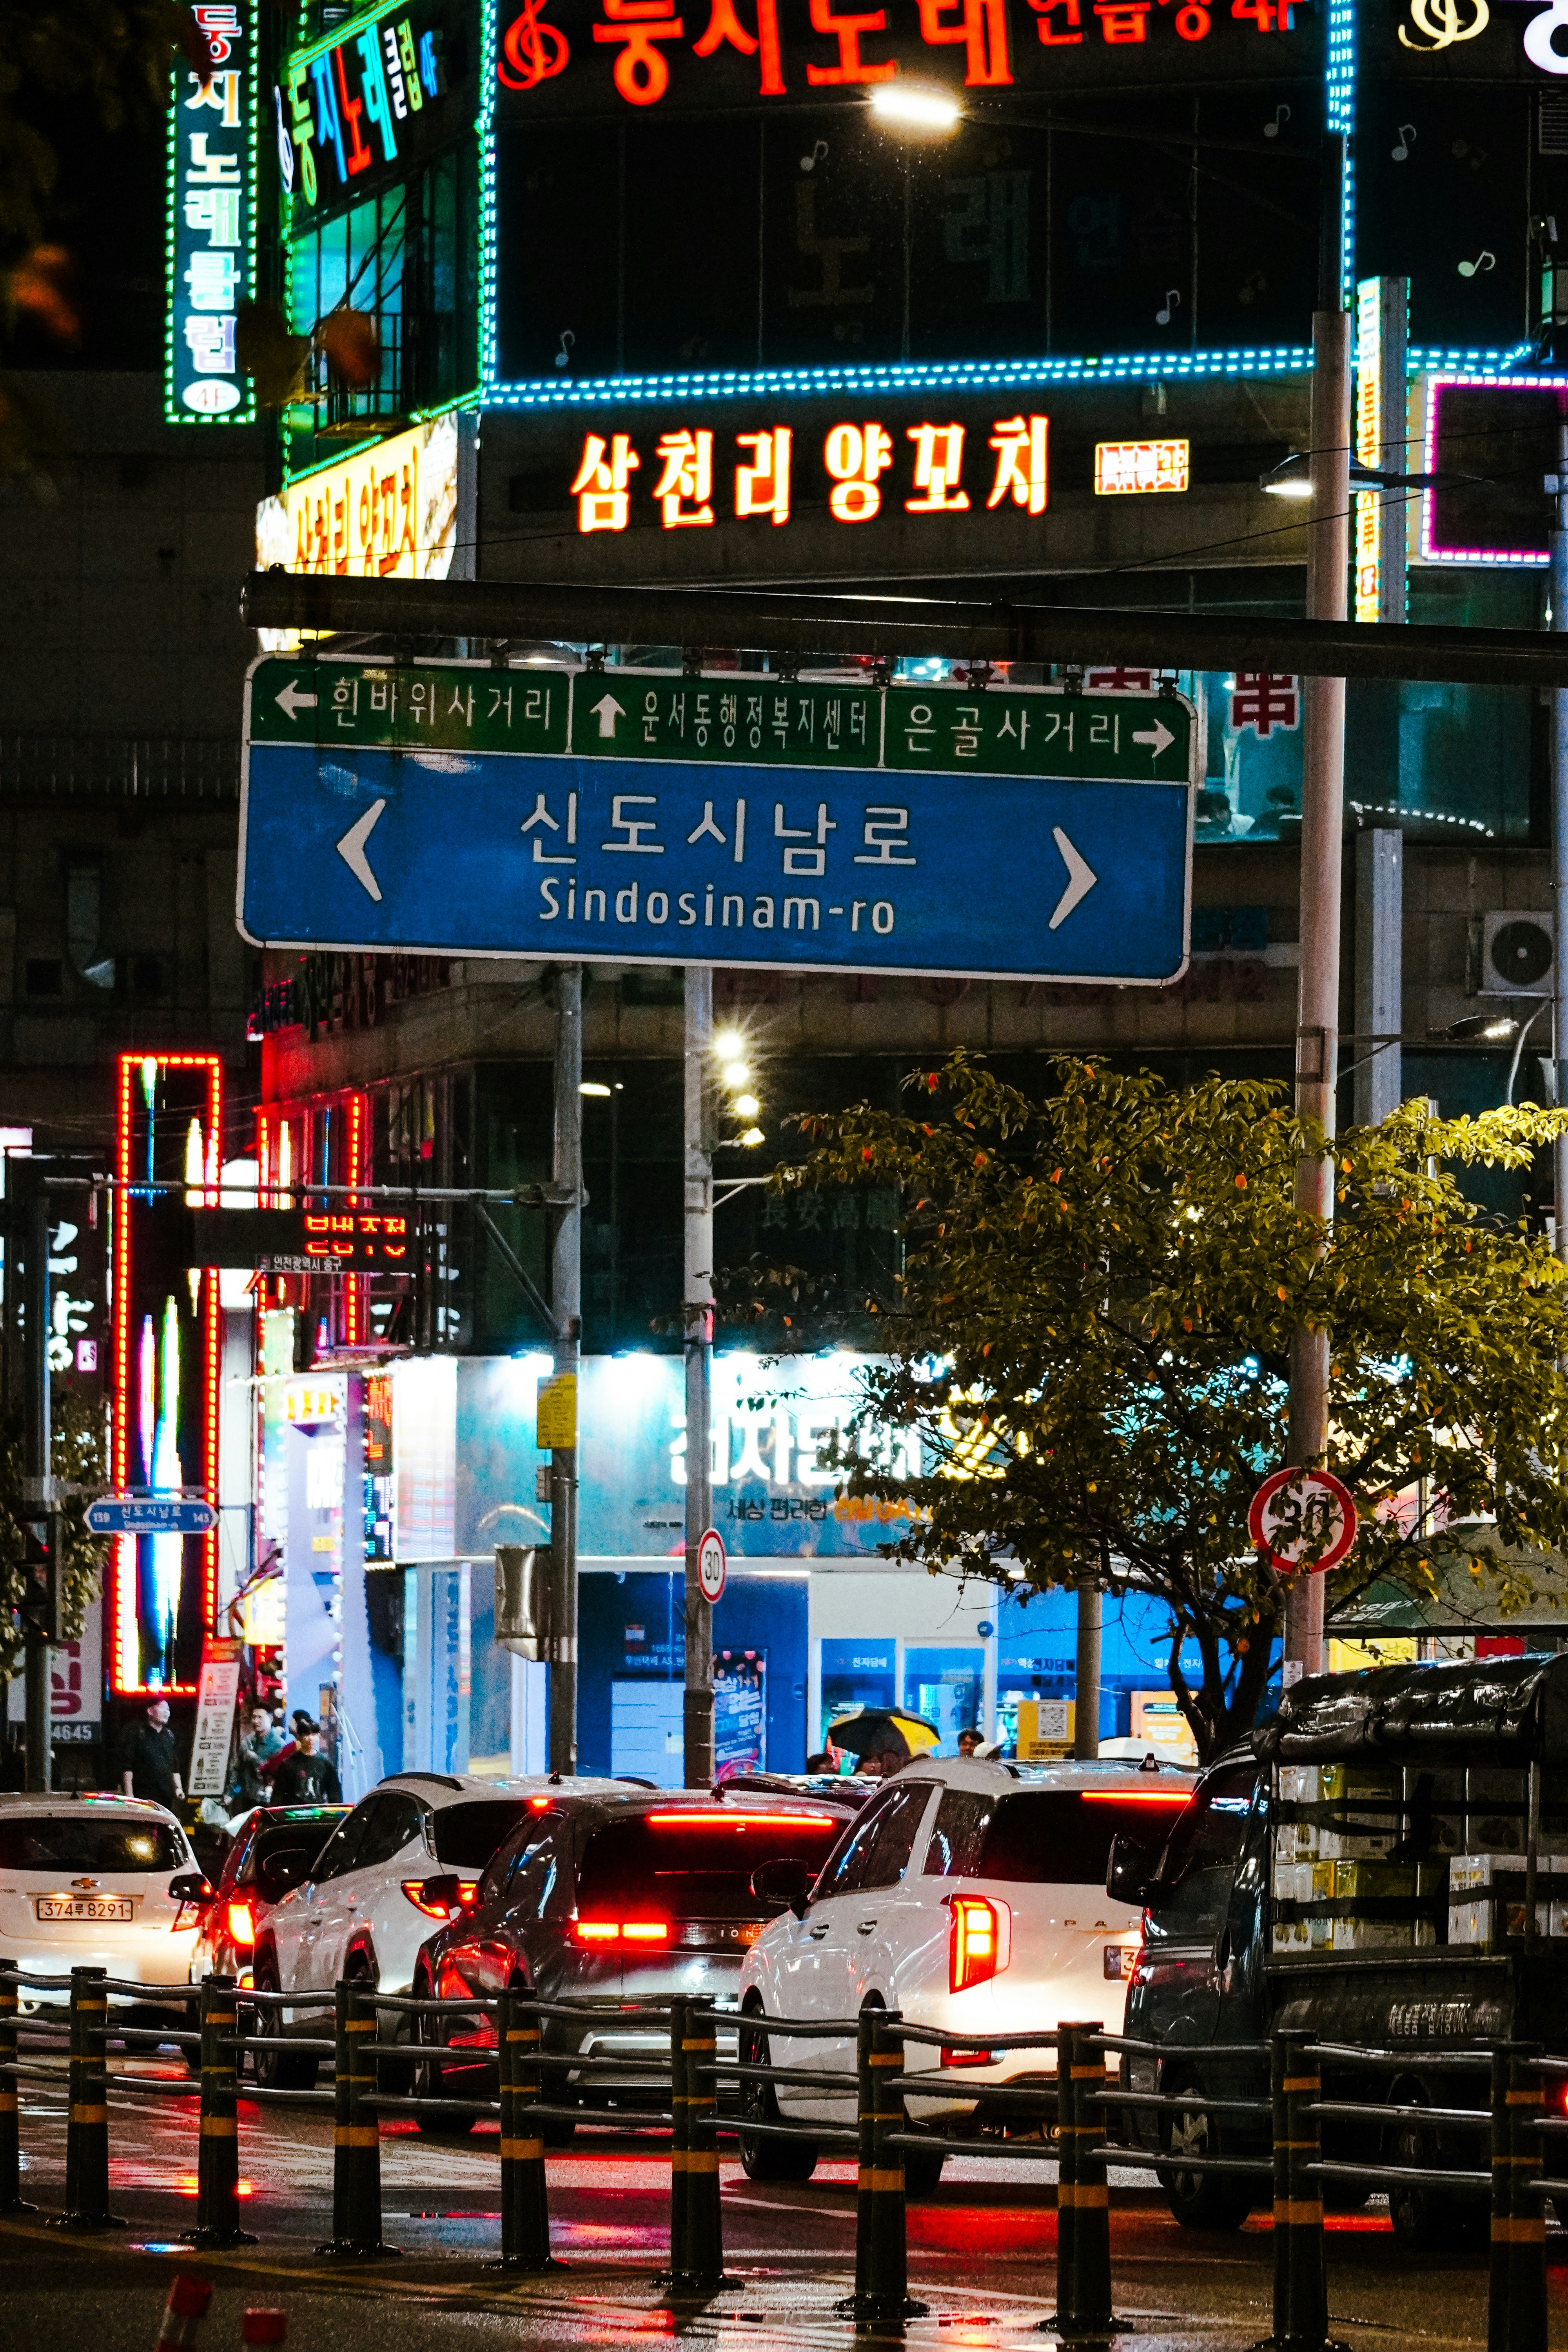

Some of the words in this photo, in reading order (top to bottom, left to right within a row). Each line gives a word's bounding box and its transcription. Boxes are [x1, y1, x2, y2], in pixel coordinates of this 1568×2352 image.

[331, 677, 551, 730] 흰바위사거리
[642, 691, 866, 750] 운서동행정복지센터
[904, 704, 1120, 757] 은골사거리
[520, 792, 916, 877] 신도시남로
[539, 877, 895, 935] Sindosinam-ro
[274, 1256, 320, 1271] 인천광역시
[324, 1256, 341, 1272] 중구
[705, 1550, 719, 1581] 30
